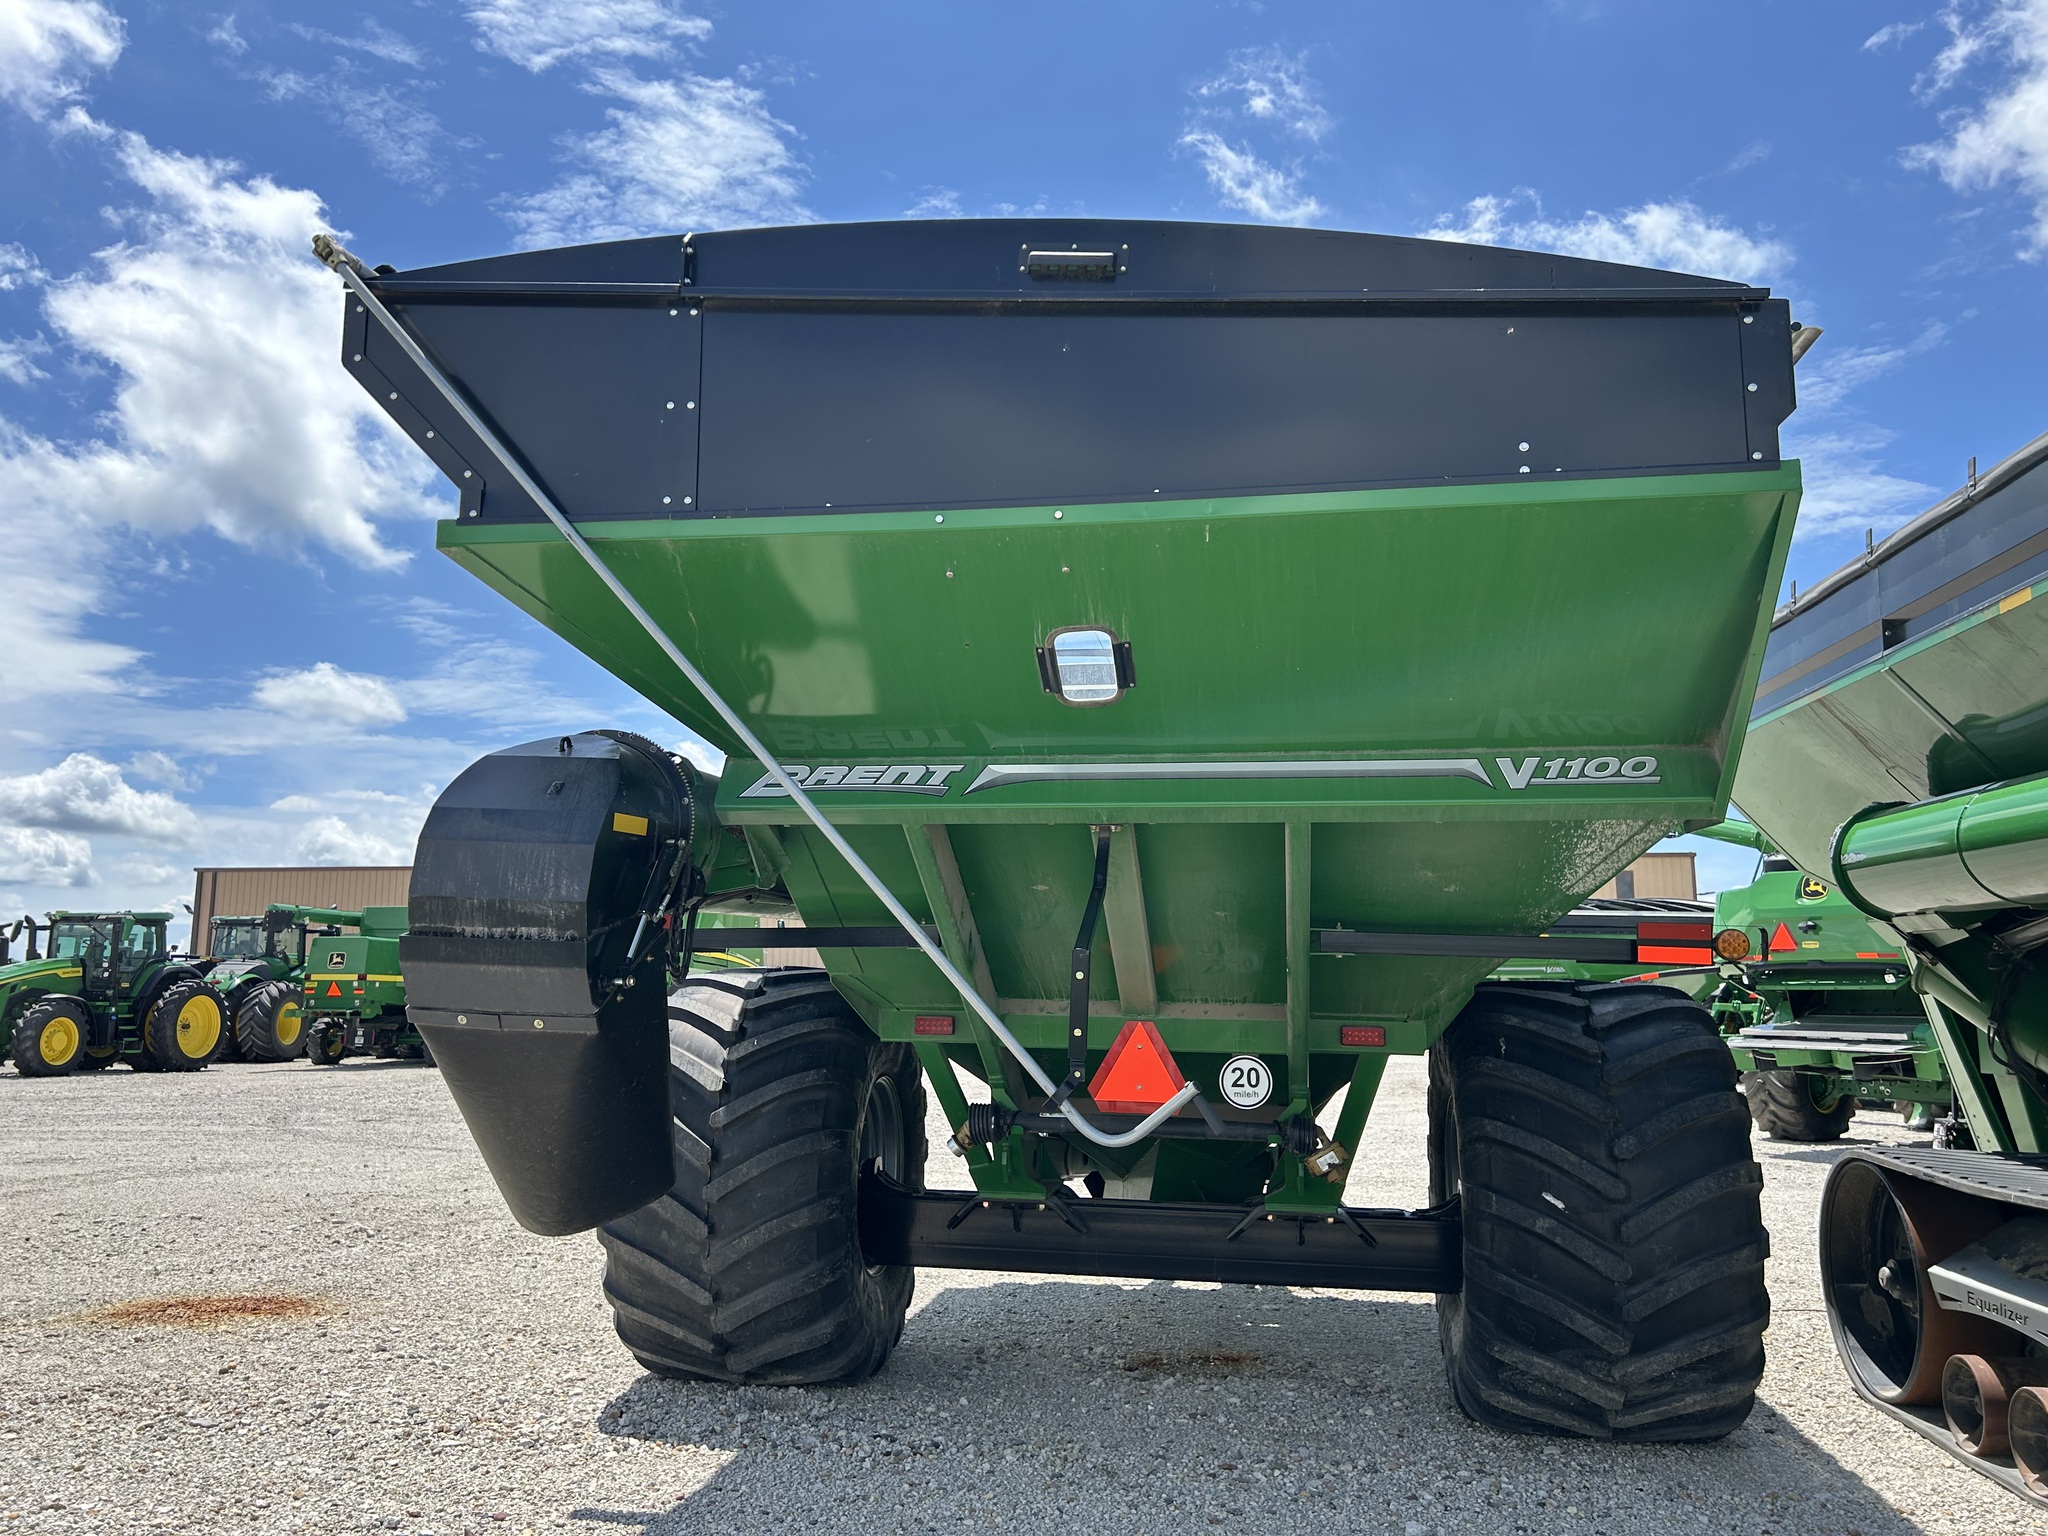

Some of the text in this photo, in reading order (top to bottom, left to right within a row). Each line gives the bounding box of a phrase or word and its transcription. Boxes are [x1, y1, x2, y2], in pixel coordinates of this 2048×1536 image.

[737, 764, 966, 798] BRENT
[1494, 755, 1659, 790] V1100
[1231, 1067, 1260, 1088] 20
[1233, 1090, 1259, 1098] mile/h
[1966, 1290, 2030, 1326] Equalizer
